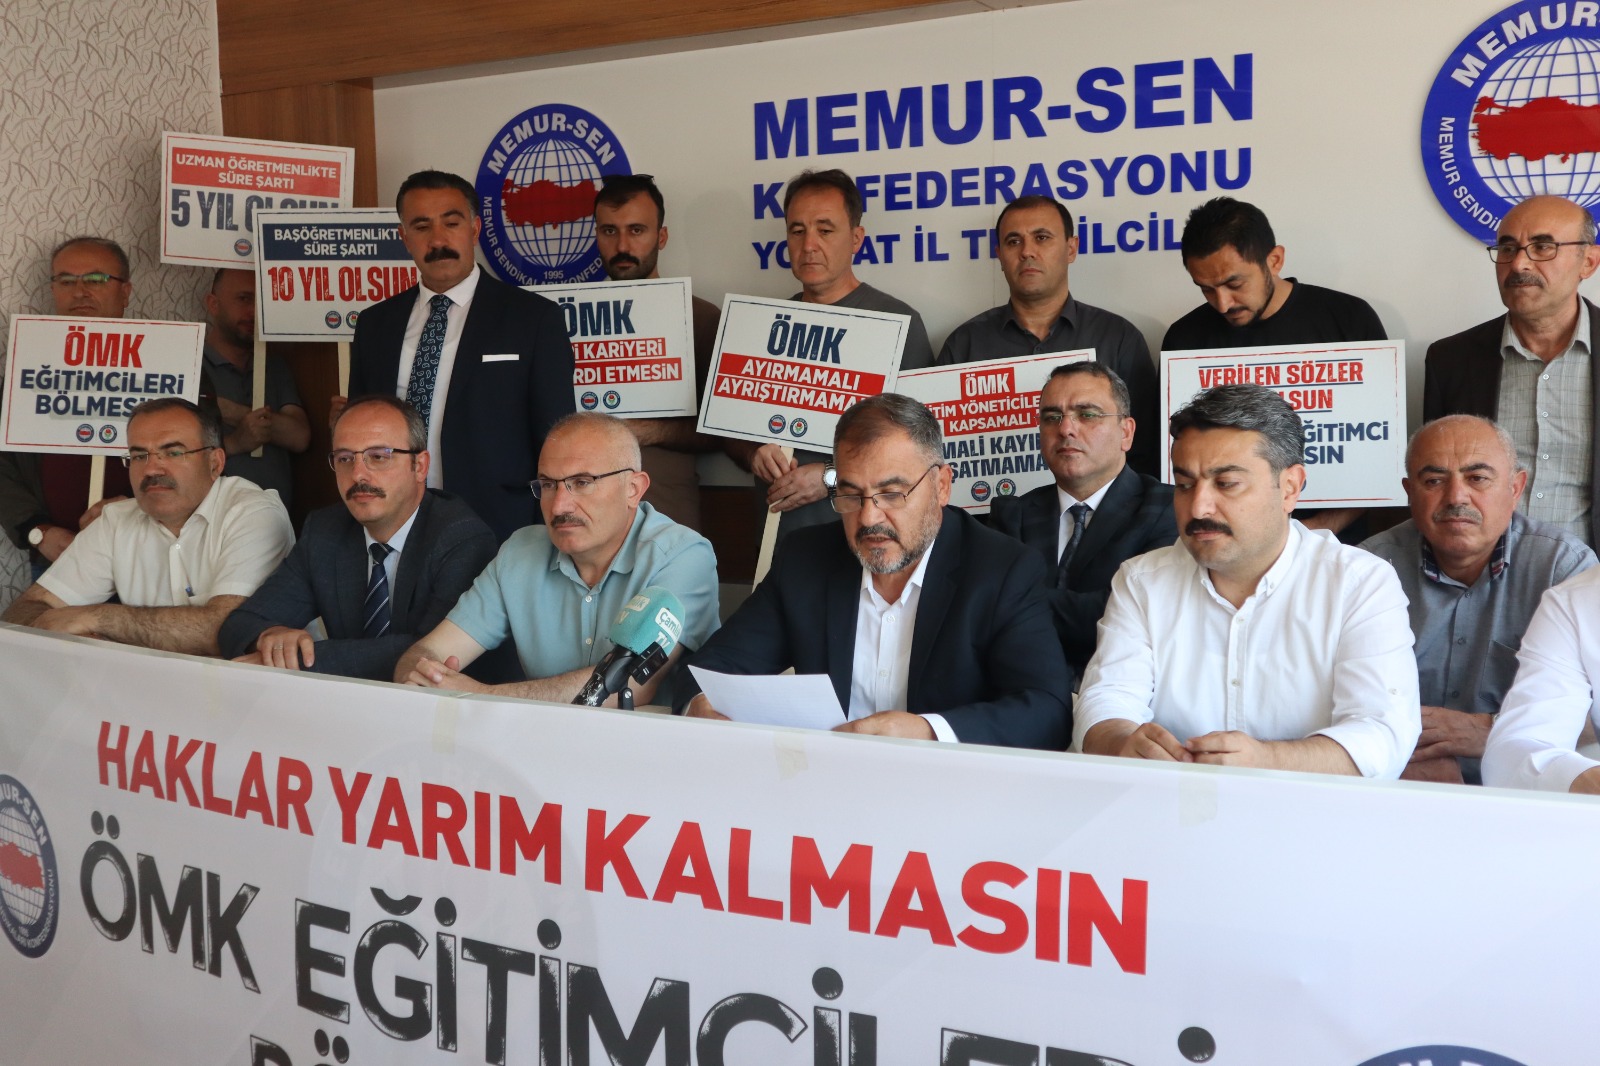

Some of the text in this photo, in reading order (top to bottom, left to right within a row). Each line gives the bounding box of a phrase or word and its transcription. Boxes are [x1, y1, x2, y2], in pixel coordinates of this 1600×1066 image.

[1451, 1, 1600, 88] MEMUR
[754, 53, 1253, 160] MEMUR-SEN
[175, 153, 225, 169] UZMAN
[486, 112, 616, 175] MEMUR-SEN
[1438, 117, 1461, 186] MEMUR
[218, 171, 295, 190] SÜRE ŞARTI
[753, 146, 1252, 220] KFEDERASYONU
[171, 188, 191, 228] 5
[197, 190, 239, 232] YIL
[483, 196, 499, 247] MEMUR
[274, 226, 403, 243] BAŞÖĞRETMENLİKT
[304, 241, 378, 257] SÜRE ŞARTI
[751, 233, 901, 270] YOAT
[914, 225, 949, 263] İL
[267, 266, 418, 302] 10 YIL OLSUN
[543, 270, 564, 280] 1995
[558, 297, 636, 338] ÖMK
[64, 326, 145, 368] ÖMK
[767, 313, 848, 364] ÖMK
[741, 358, 861, 391] AYIRMAMALI
[965, 373, 1011, 397] ÖMK
[1198, 361, 1363, 389] VERİLEN SÖZLER
[35, 390, 152, 418] BÖLMES
[717, 377, 864, 412] AYRIŞTIRMAMA
[959, 394, 1041, 416] YÖNETİCİLE
[1279, 388, 1333, 412] SUN
[949, 412, 1031, 433] KAPSAMALI
[1303, 420, 1389, 443] ĞİTİMCİ
[0, 782, 47, 846] UR-SEN
[98, 720, 1149, 976] HAKLAR YARIM KALMASIN
[80, 810, 261, 995] ÖMK
